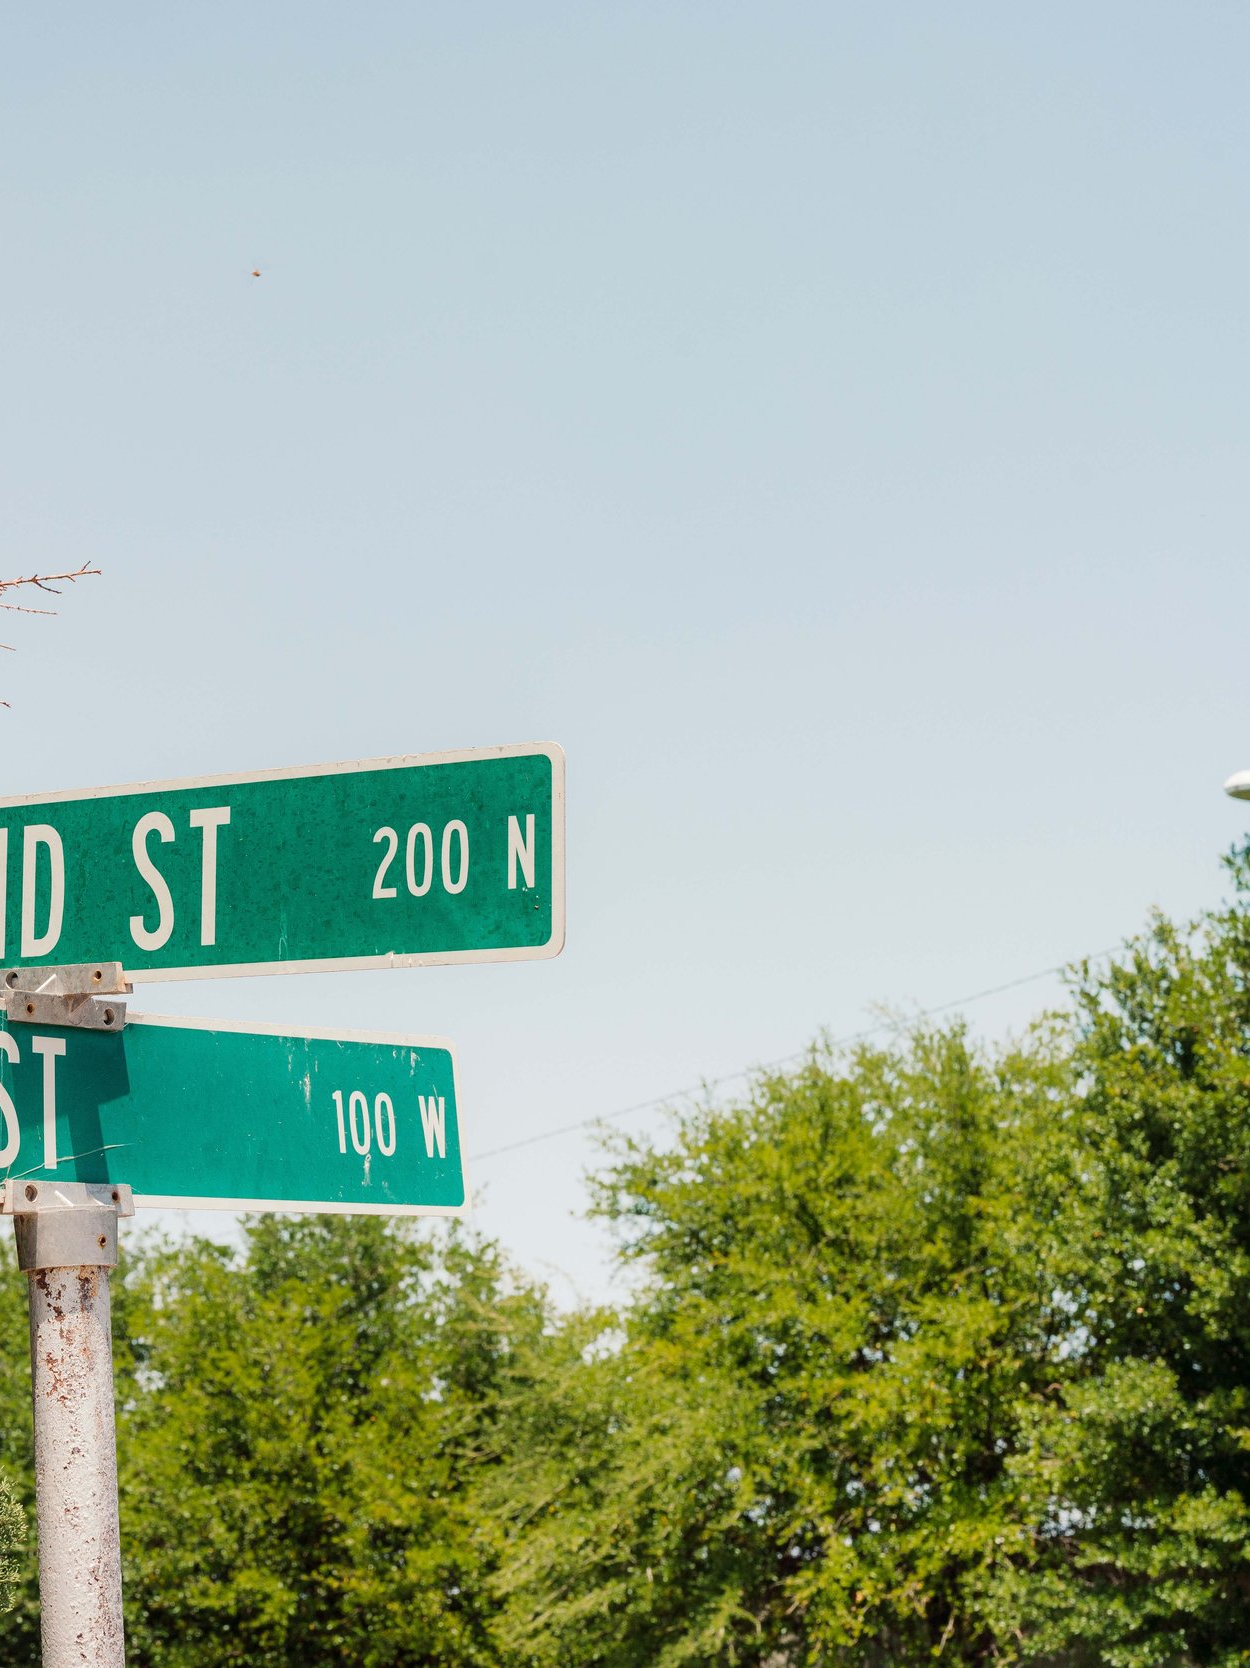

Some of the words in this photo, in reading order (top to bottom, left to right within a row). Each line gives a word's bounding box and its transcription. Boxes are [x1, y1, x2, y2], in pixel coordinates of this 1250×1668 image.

[129, 806, 231, 951] ST
[372, 819, 470, 899] 200
[507, 813, 535, 889] N
[332, 1090, 396, 1157] 100
[418, 1095, 446, 1159] W
